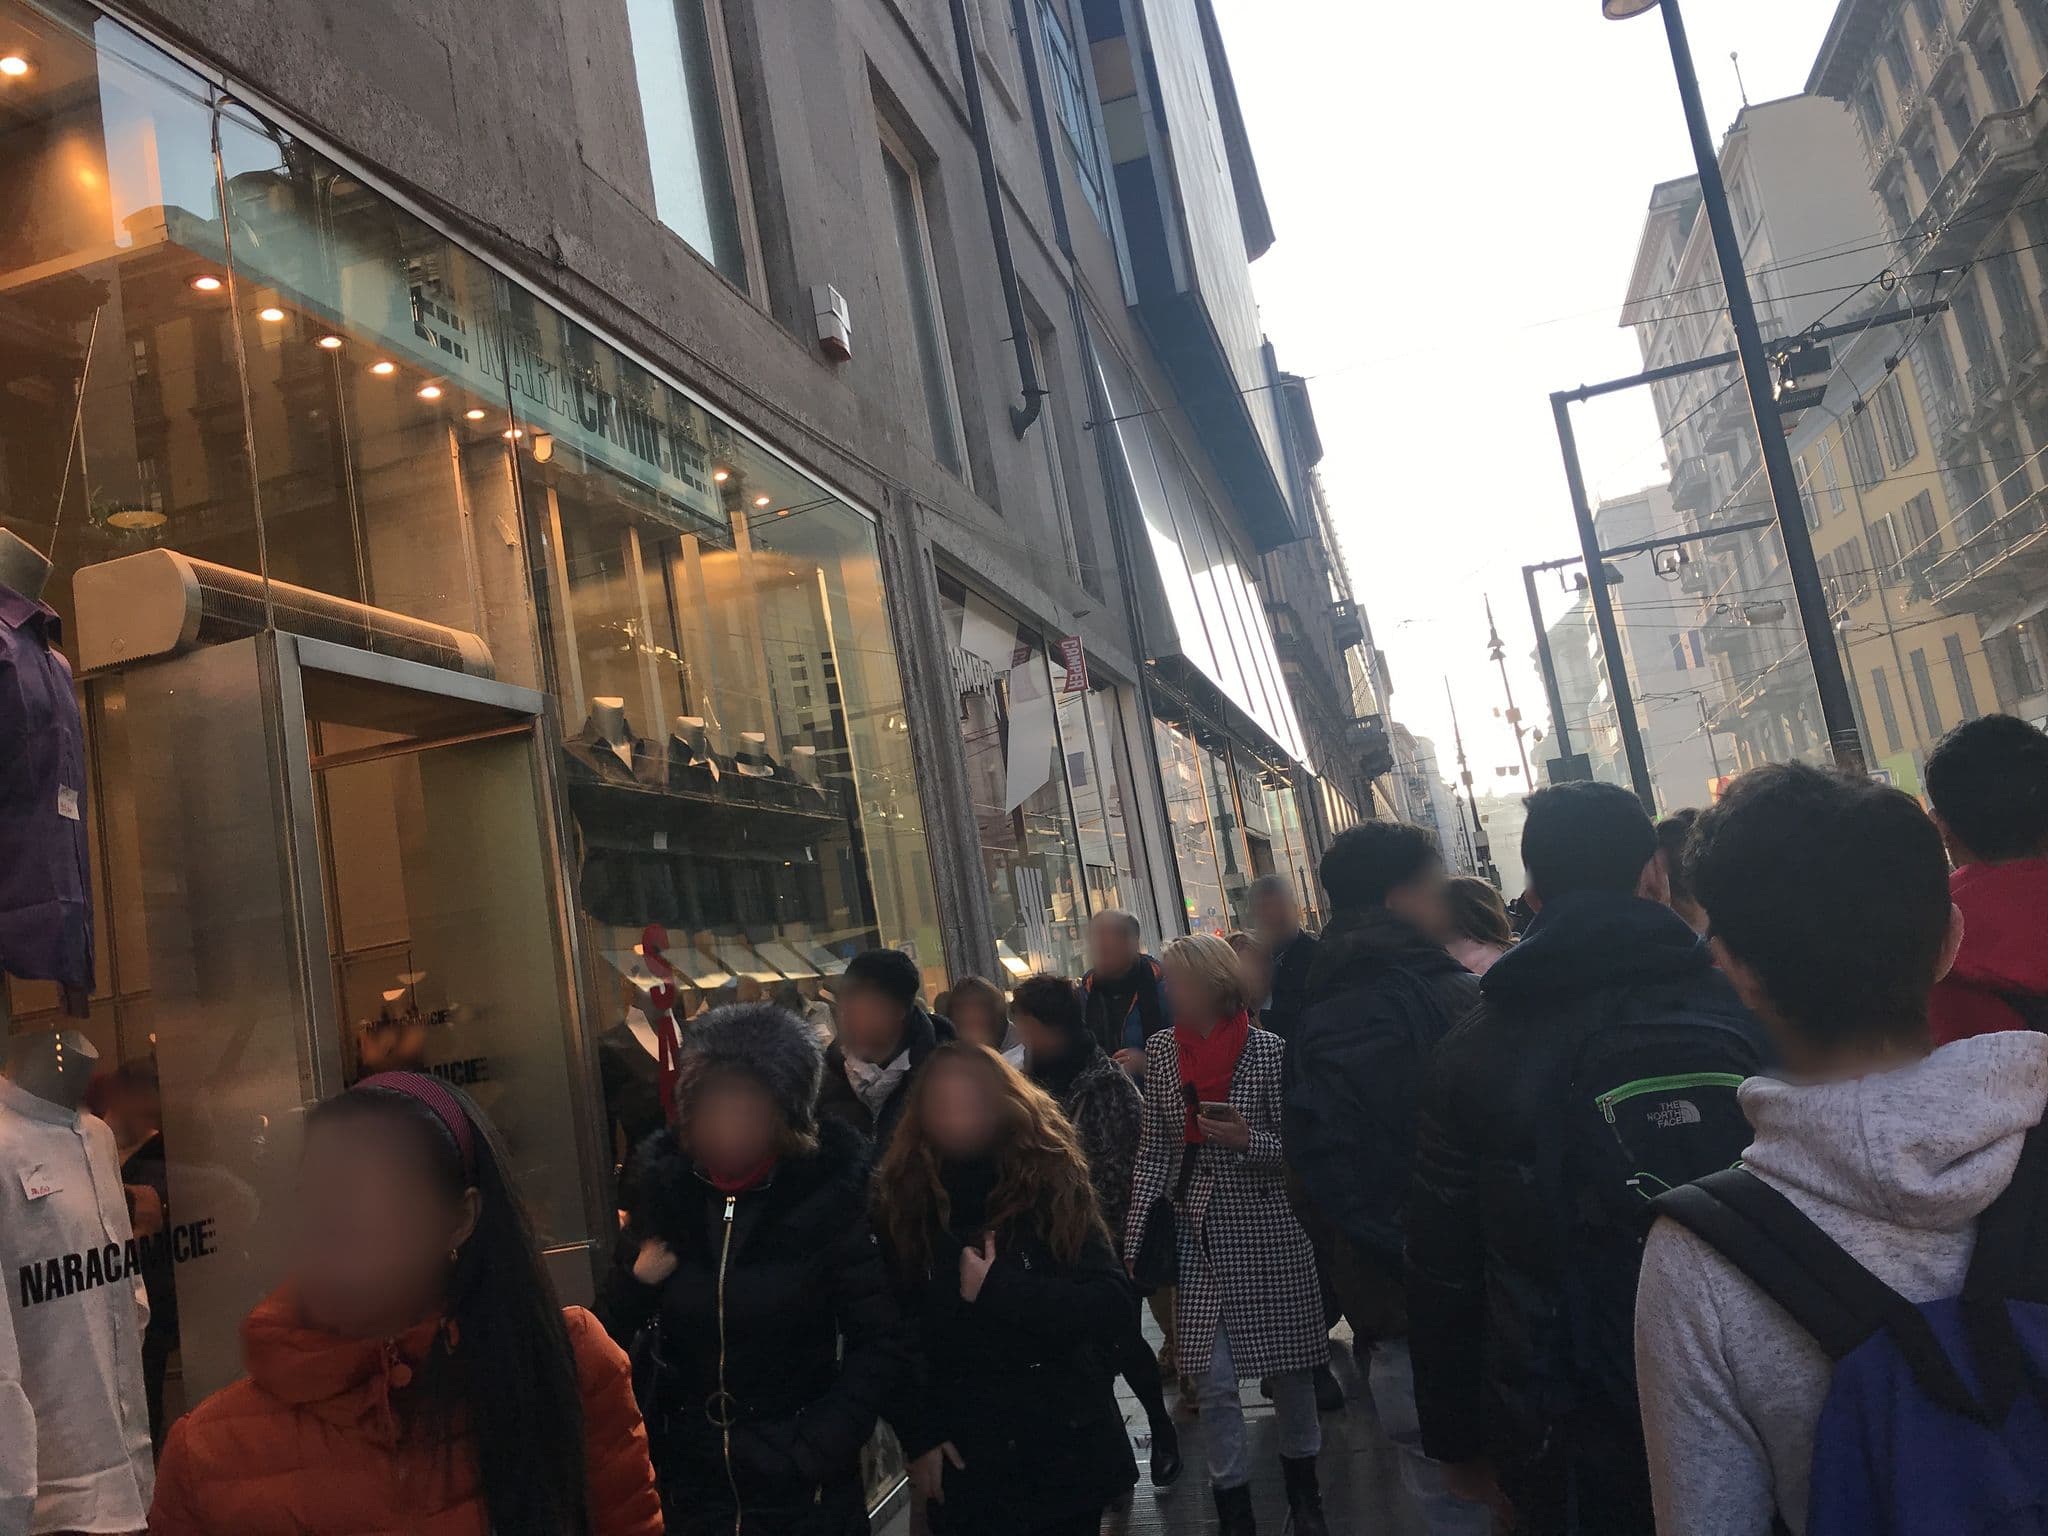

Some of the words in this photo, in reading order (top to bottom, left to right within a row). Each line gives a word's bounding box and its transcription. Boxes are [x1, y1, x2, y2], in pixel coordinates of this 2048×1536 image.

[1061, 640, 1085, 690] CAMPER
[1659, 1100, 1680, 1110] THE
[1646, 1109, 1681, 1121] NORTH
[1657, 1117, 1682, 1128] FACE
